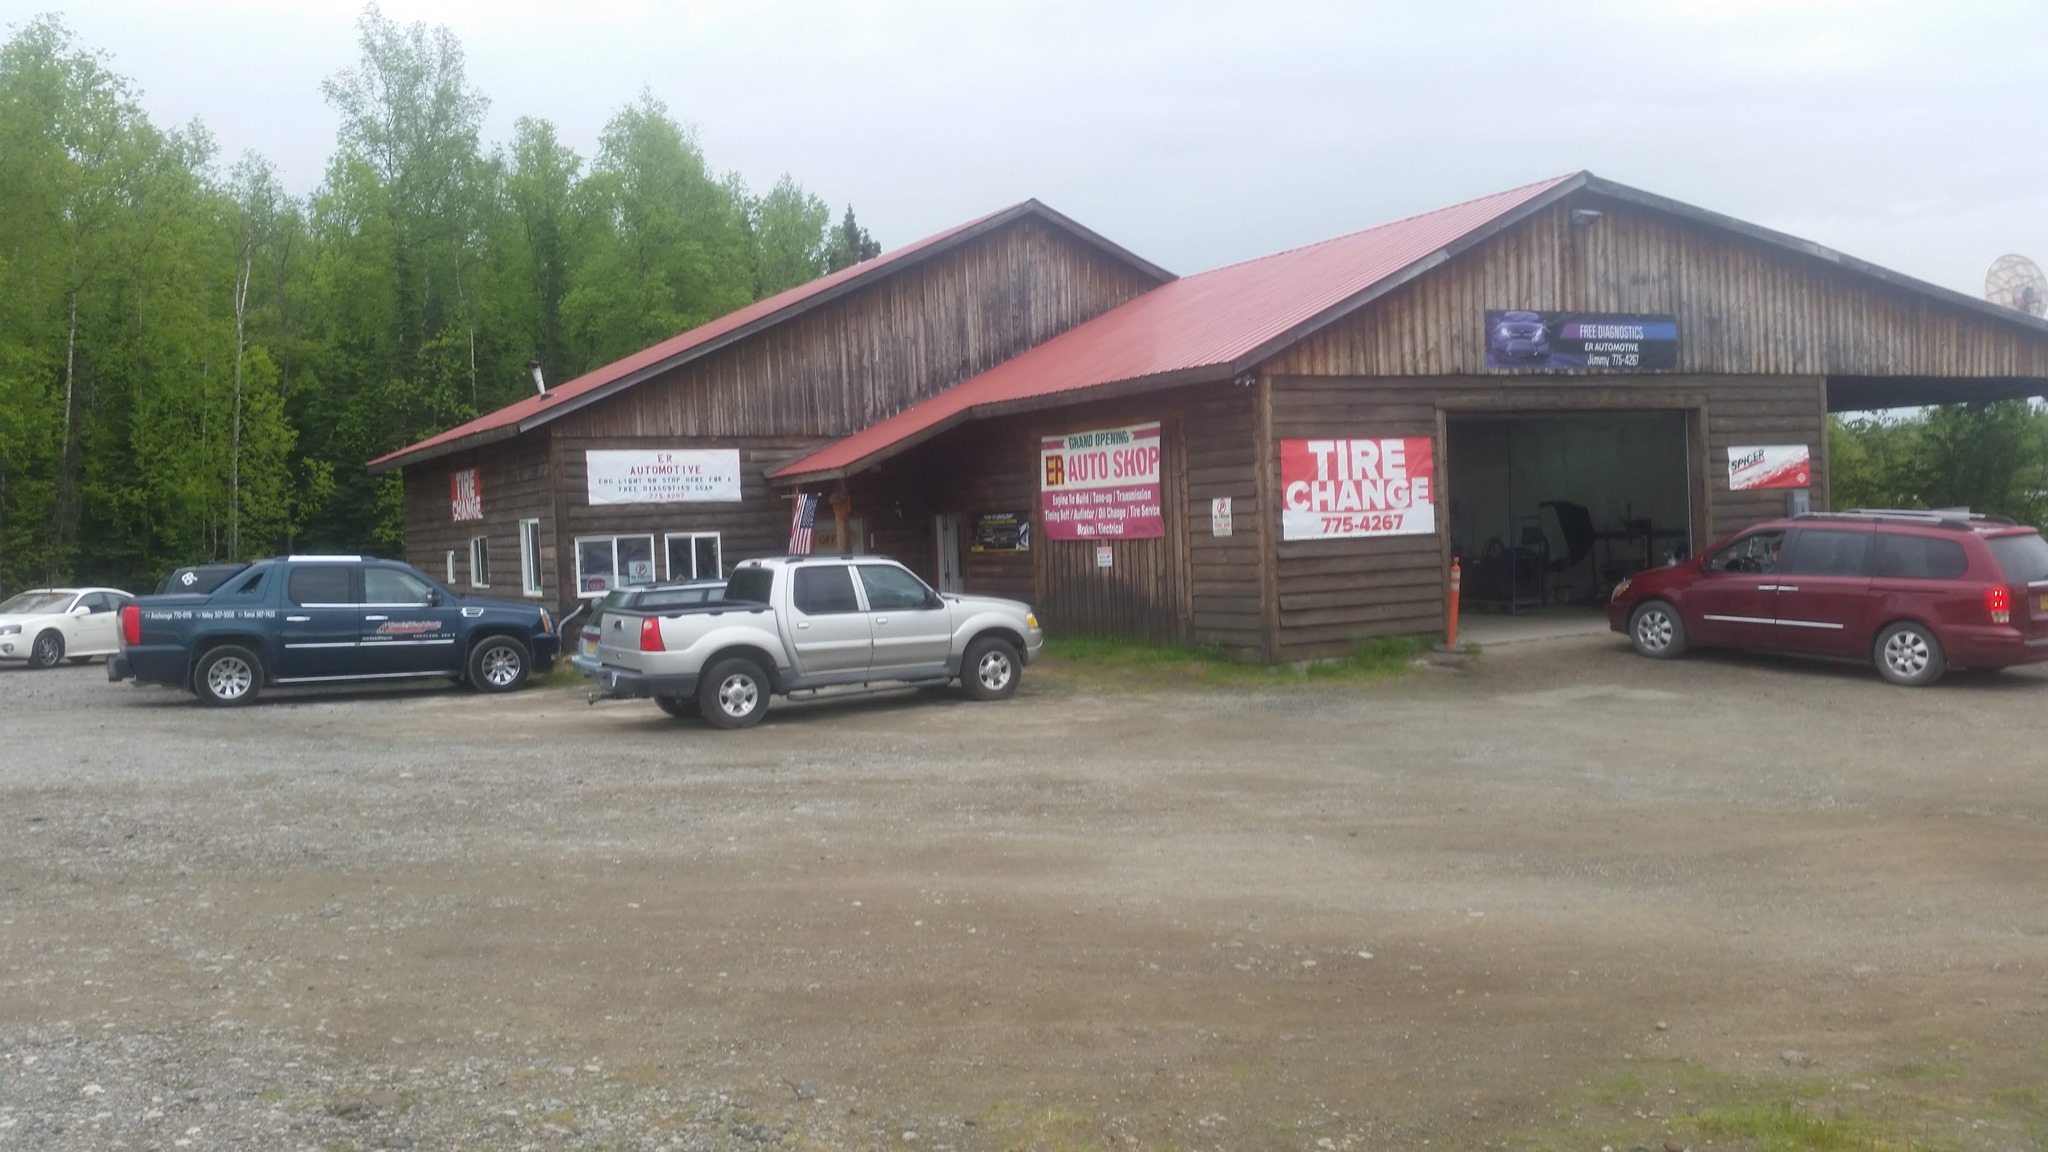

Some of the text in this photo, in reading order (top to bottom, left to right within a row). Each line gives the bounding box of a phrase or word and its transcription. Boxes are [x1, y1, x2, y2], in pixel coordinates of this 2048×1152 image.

[1579, 324, 1644, 340] FREE DIAGNOSTICS
[1595, 342, 1639, 352] AUTOMOTIVE
[1587, 354, 1609, 367] Jimmy
[1068, 430, 1129, 450] GRAND OPENING
[657, 454, 673, 463] ER
[1045, 446, 1160, 486] ER AUTO SHOP
[1308, 438, 1407, 481] TIRE
[1730, 449, 1765, 471] SPICER
[630, 465, 702, 475] AUTOMOTIVE
[455, 469, 475, 500] TIRE
[662, 476, 681, 484] STOP
[1116, 489, 1152, 502] Transmission
[1286, 477, 1429, 512] CHANGE
[452, 495, 481, 522] CHANGE
[1106, 507, 1126, 521] Change
[1130, 505, 1141, 517] Tire
[1141, 504, 1160, 517] Service
[1098, 522, 1124, 535] Electrical
[1321, 514, 1404, 534] 775-4267
